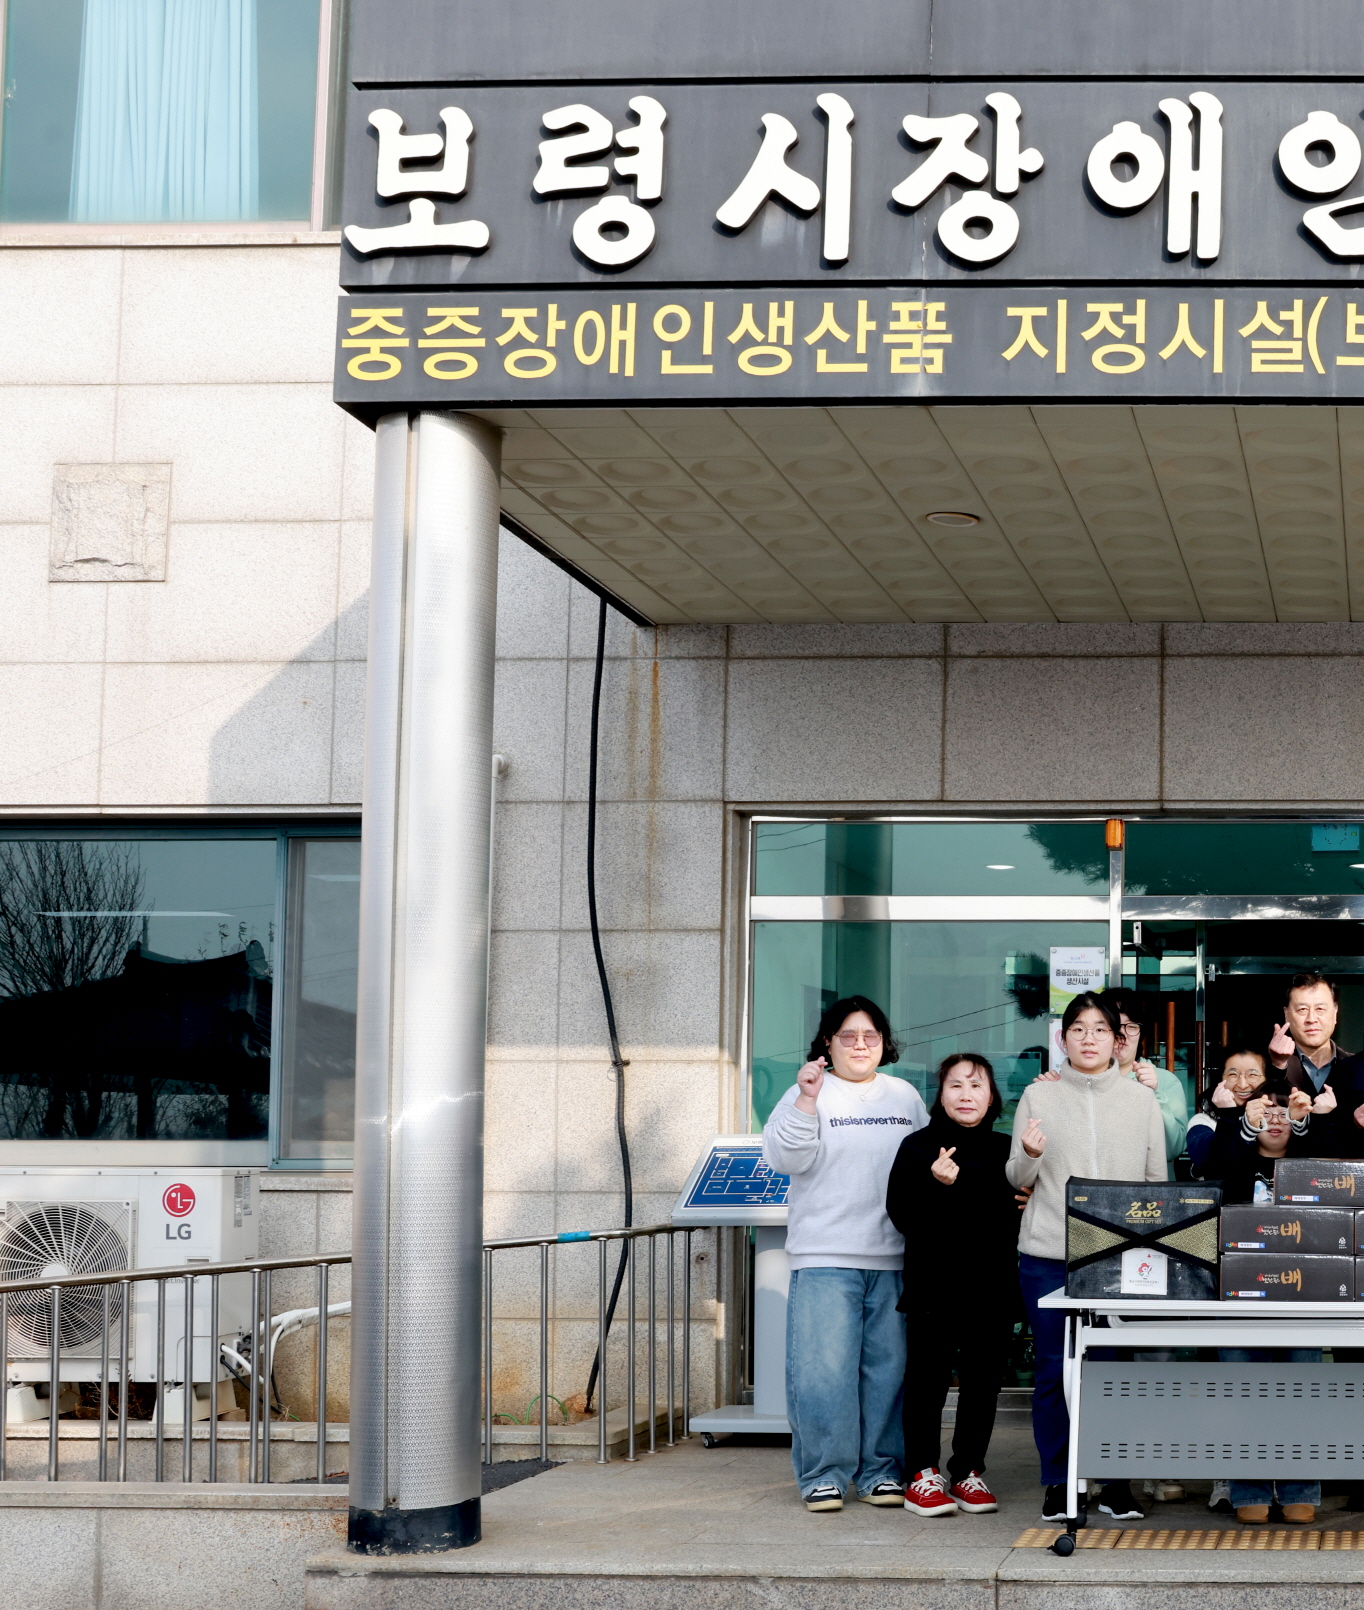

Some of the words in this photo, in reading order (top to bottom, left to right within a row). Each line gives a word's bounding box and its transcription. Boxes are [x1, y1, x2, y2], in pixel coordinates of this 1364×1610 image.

[341, 299, 953, 381] 중증장애인생산품
[1334, 1174, 1356, 1197] 배
[1125, 1201, 1162, 1218] 名品
[165, 1223, 192, 1240] LG
[1280, 1220, 1302, 1244] 배
[1280, 1268, 1302, 1292] 배
